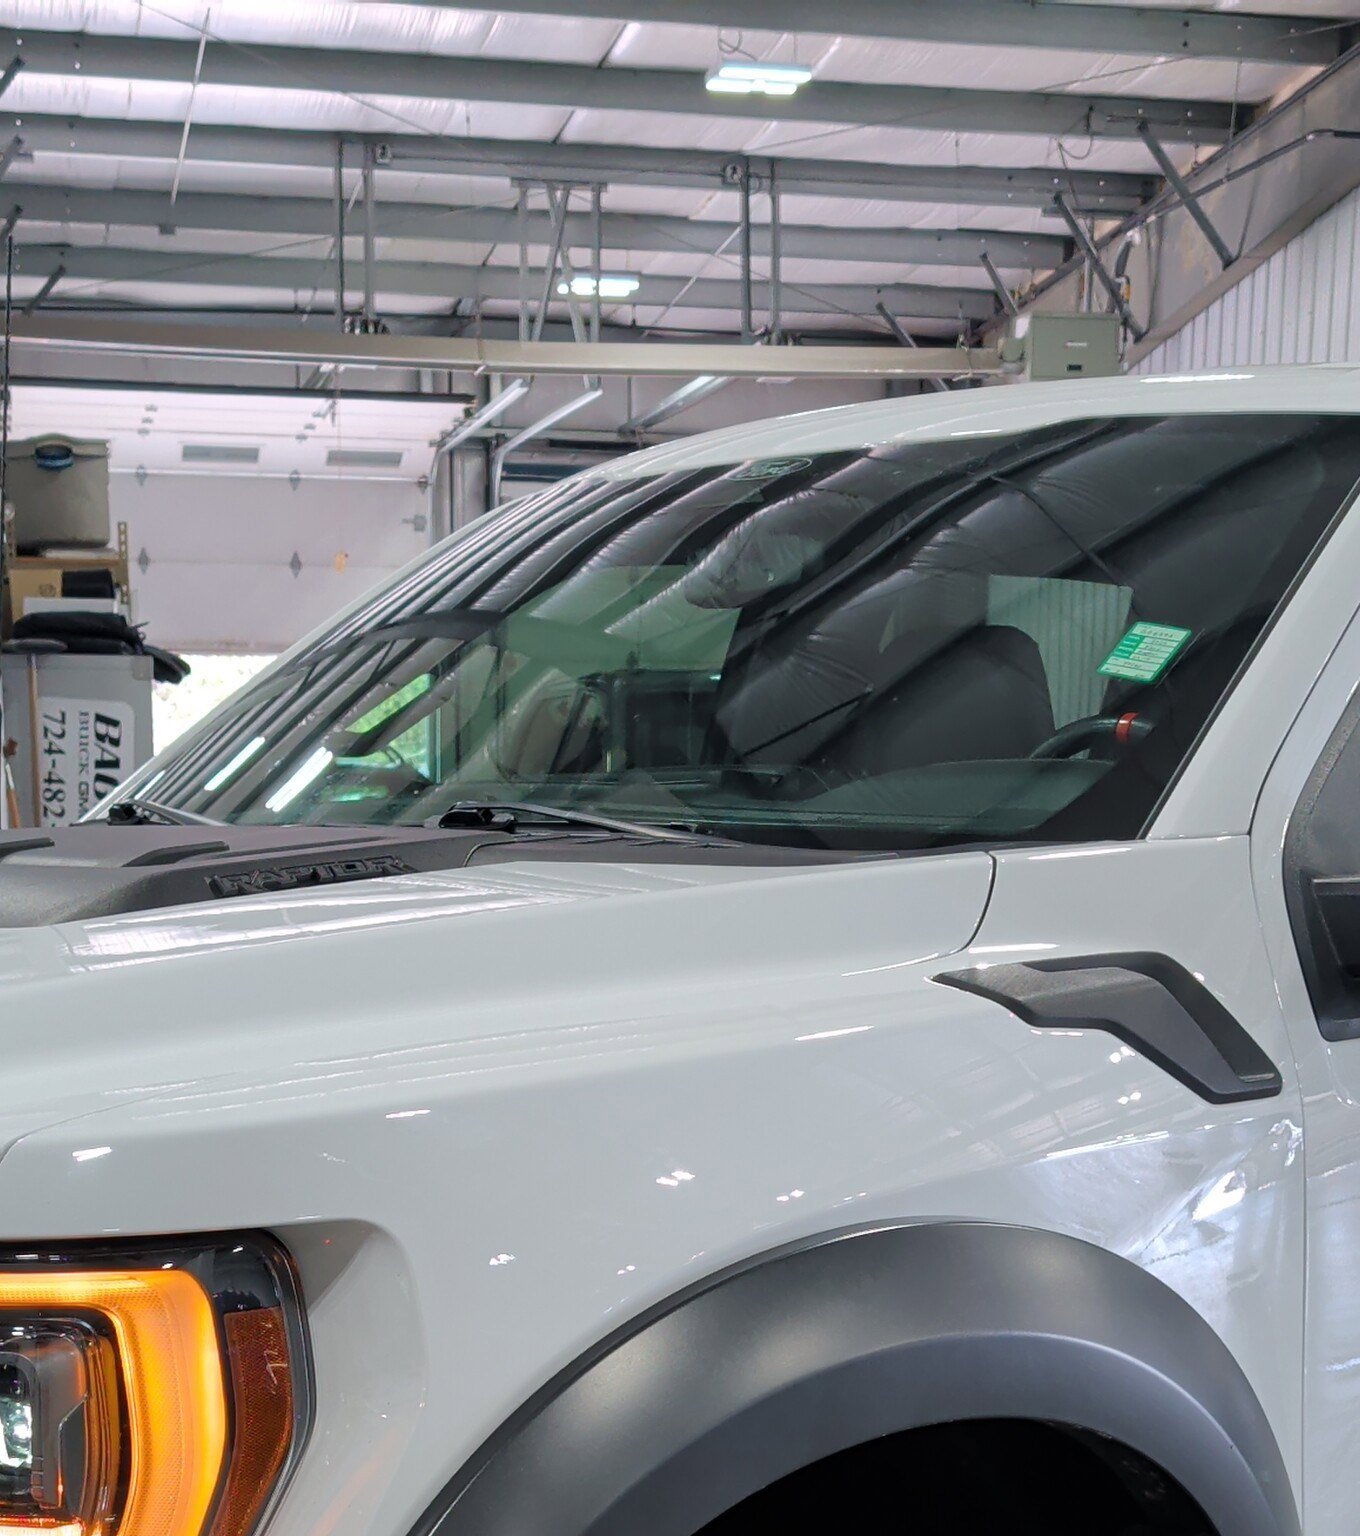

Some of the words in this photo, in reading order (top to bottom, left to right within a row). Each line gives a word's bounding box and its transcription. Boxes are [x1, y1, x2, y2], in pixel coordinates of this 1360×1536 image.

[79, 711, 90, 775] BUICK
[79, 781, 90, 821] GM
[204, 856, 420, 898] RAPTOR
